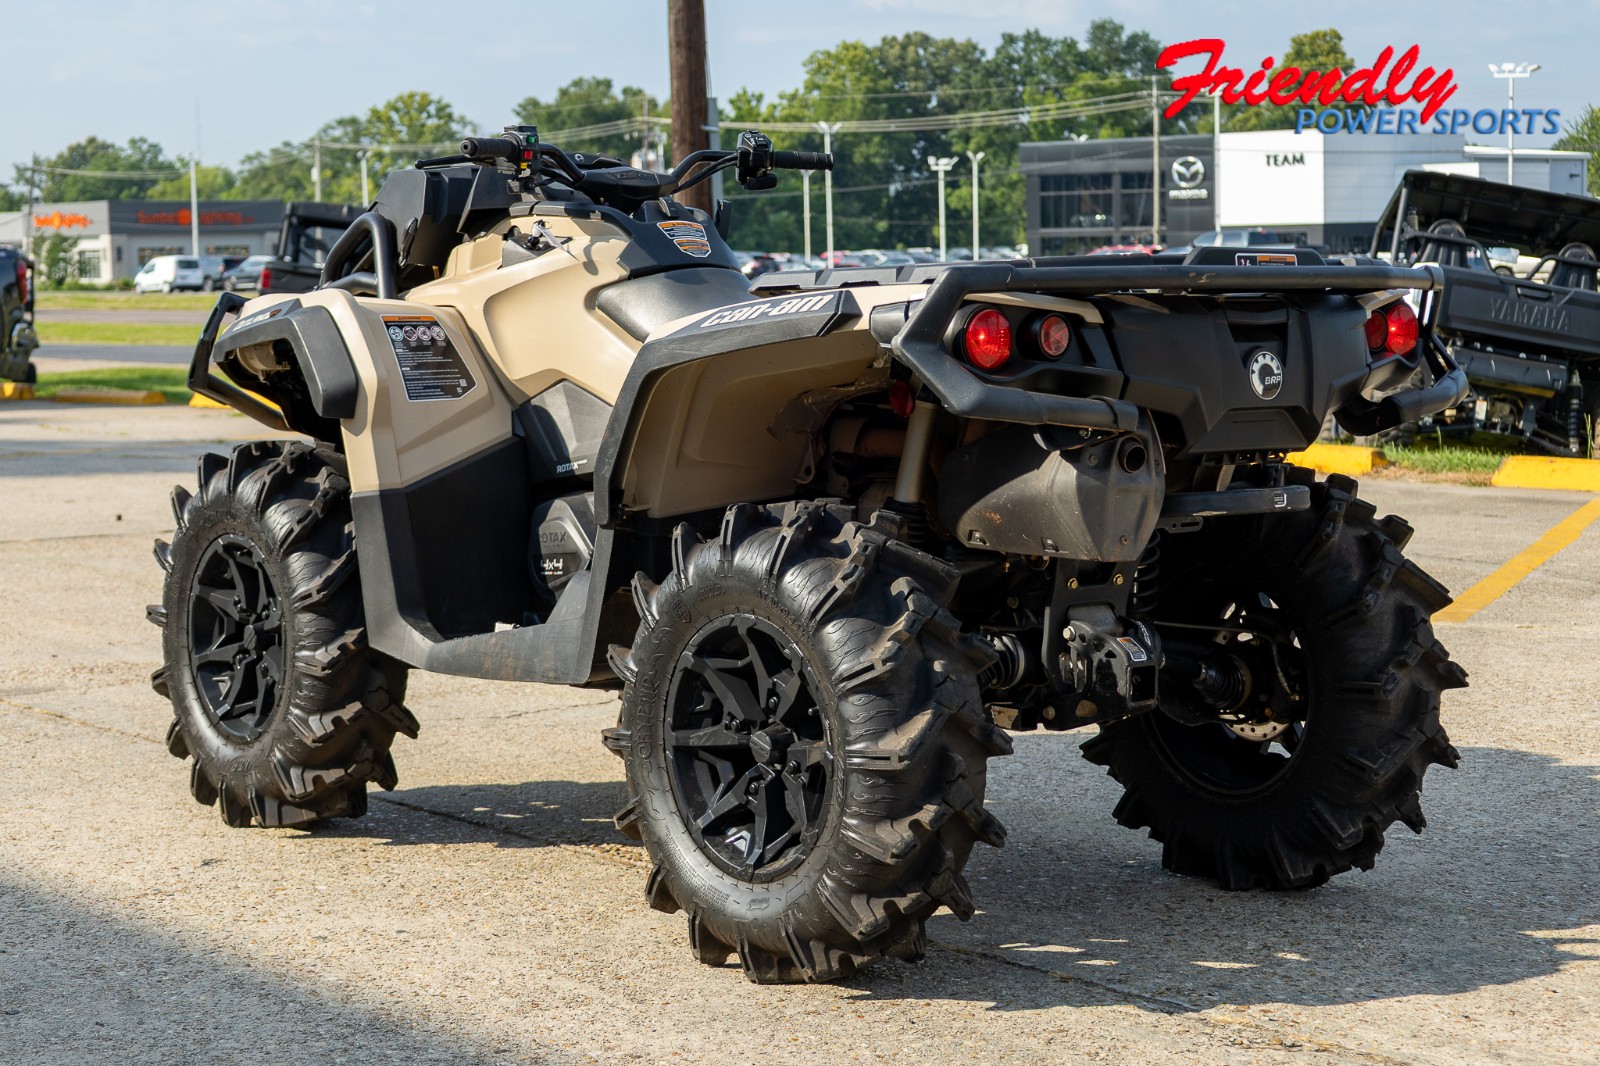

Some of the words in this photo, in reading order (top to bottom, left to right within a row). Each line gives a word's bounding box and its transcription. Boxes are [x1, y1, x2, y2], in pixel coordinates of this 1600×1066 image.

[1266, 153, 1306, 167] TEAM
[1490, 297, 1570, 332] YAMAHA
[1265, 376, 1281, 385] BRP
[557, 461, 579, 474] ROTAX
[541, 559, 563, 571] 4x4
